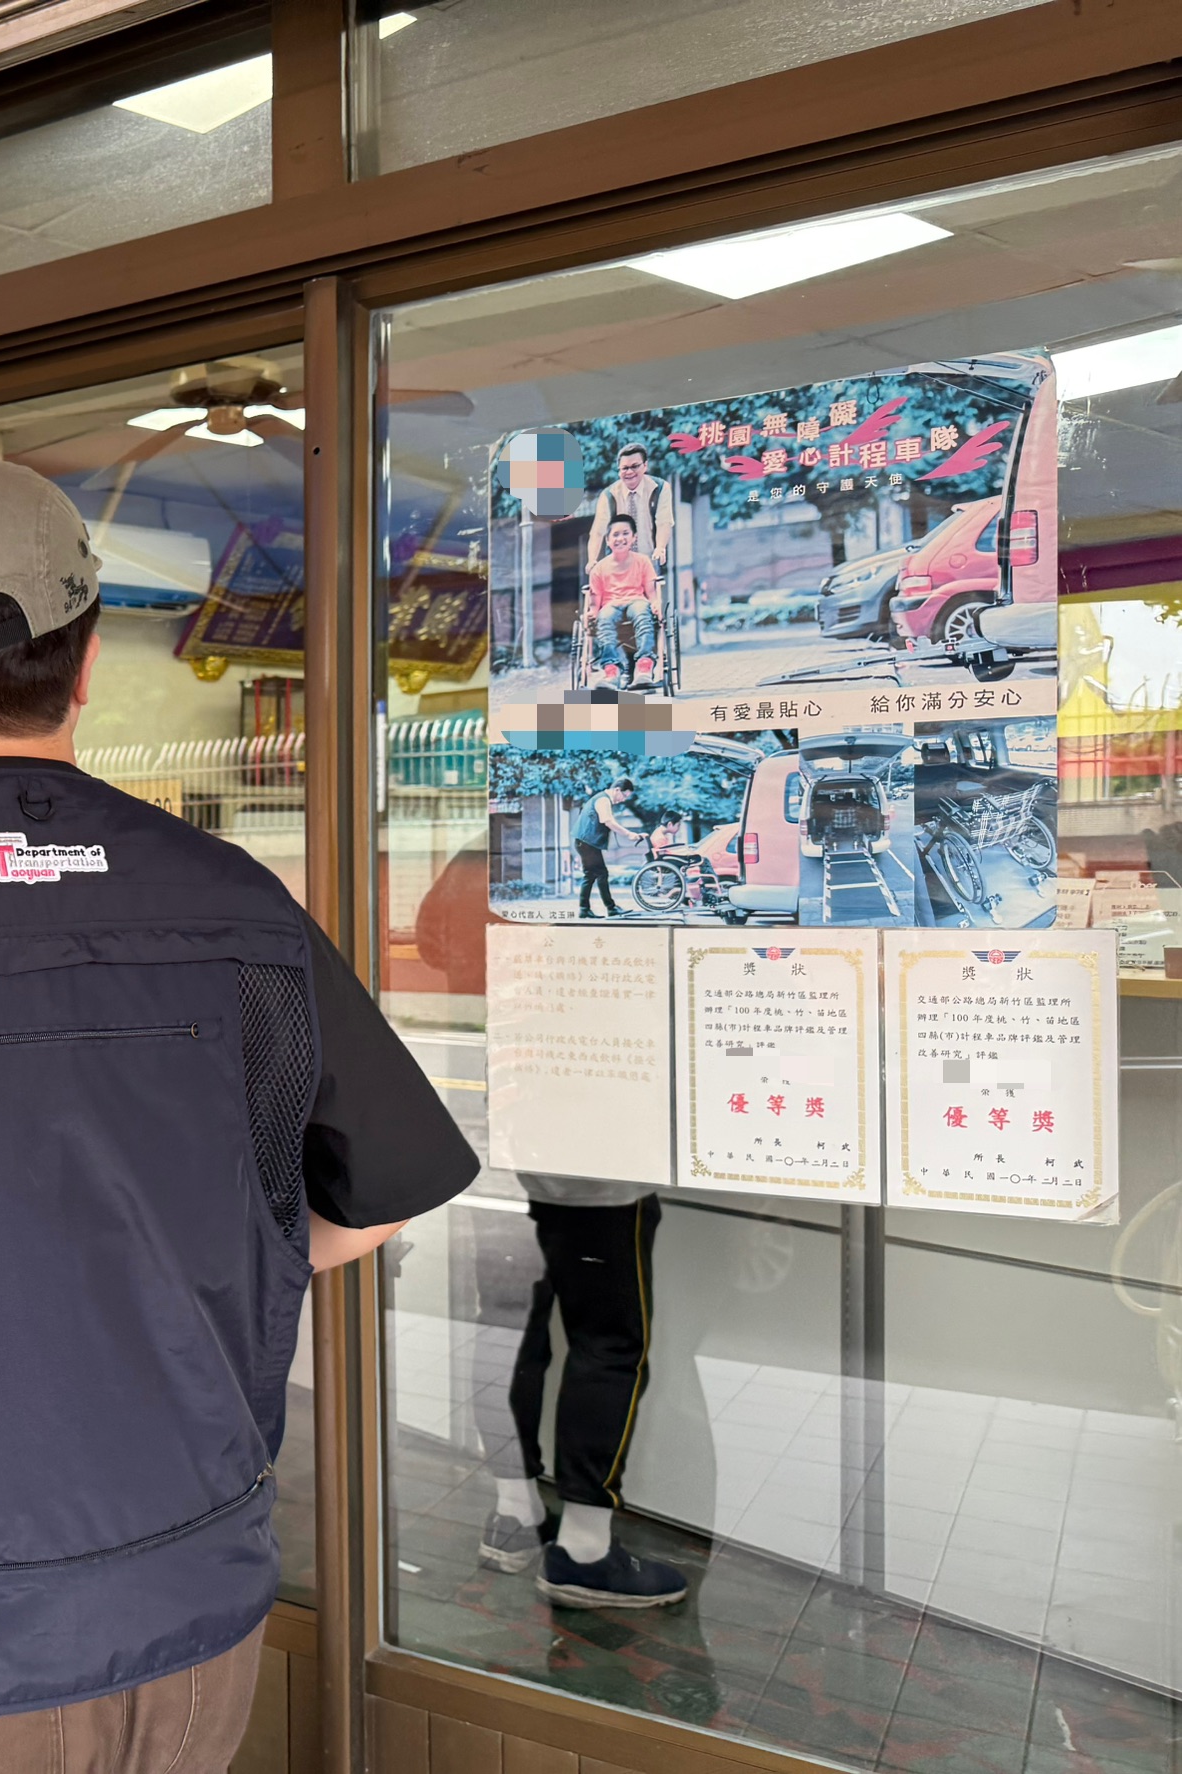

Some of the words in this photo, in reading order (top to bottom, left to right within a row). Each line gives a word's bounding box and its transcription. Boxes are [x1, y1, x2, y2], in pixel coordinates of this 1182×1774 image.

[698, 399, 858, 448] 桃園無障礙
[761, 424, 959, 475] 愛心計程車隊
[747, 473, 904, 502] 是您的守護天使
[710, 700, 823, 722] 有愛最貼心
[870, 687, 1023, 713] 給你滿分安心
[16, 847, 85, 859] Department
[90, 847, 102, 857] of
[743, 962, 807, 976] 獎狀
[962, 966, 1034, 981] 獎狀
[917, 995, 1072, 1007] 交通部公路總局新竹區監理所
[727, 1092, 826, 1119] 優等獎
[942, 1105, 1055, 1134] 優等獎
